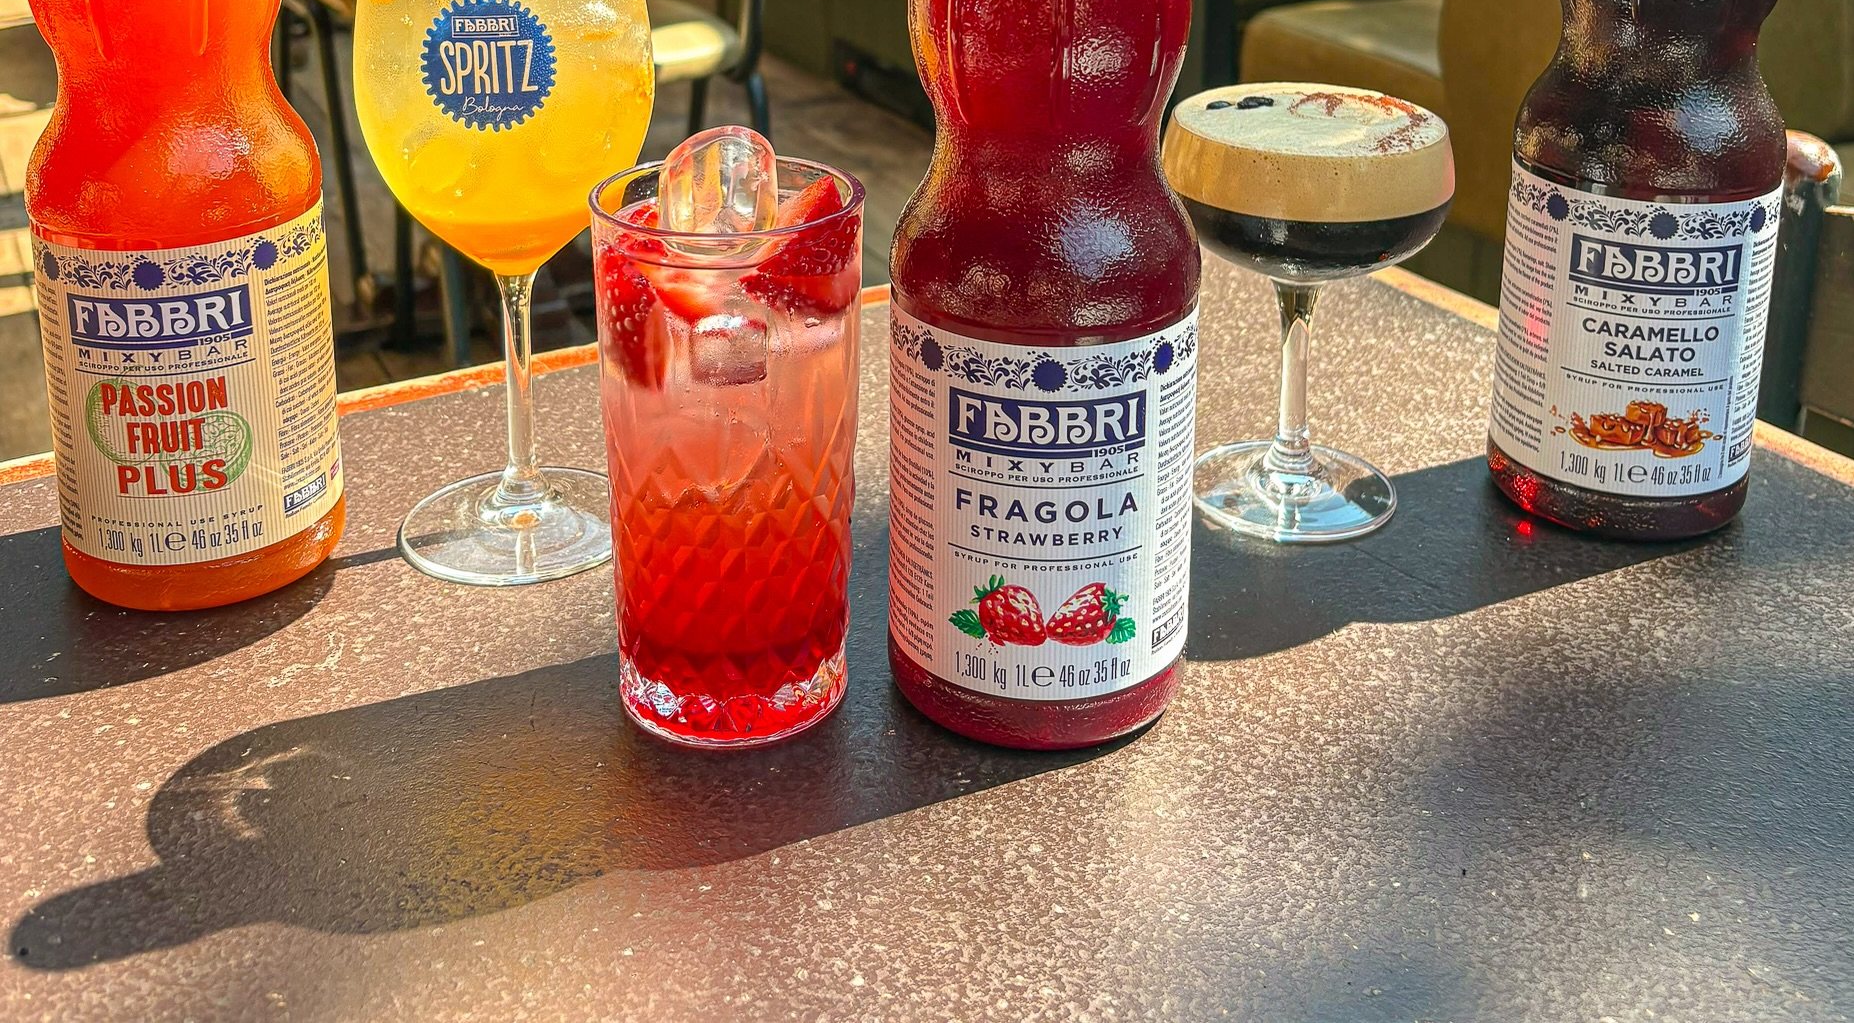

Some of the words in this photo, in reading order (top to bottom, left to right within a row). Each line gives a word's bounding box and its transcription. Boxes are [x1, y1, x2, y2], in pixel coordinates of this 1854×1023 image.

[455, 18, 515, 32] FABBRI
[439, 39, 538, 95] SPRITZ
[462, 96, 524, 121] Bologna
[1577, 239, 1737, 285] FABBRI
[1574, 284, 1733, 308] MIXYBAR
[1695, 287, 1722, 296] 1905
[72, 290, 245, 338] FABBRI
[1573, 296, 1618, 310] SCIROPPO
[1620, 305, 1638, 313] PER
[1664, 306, 1731, 316] PROFESSIONALE
[200, 333, 231, 346] 1905
[1582, 317, 1719, 343] CARAMELLO
[78, 338, 248, 363] MIXYBAR
[79, 361, 120, 371] SCIROPPO
[144, 364, 165, 372] USO
[168, 351, 248, 370] PROFESSIONALE
[1604, 341, 1696, 362] SALATO
[1590, 360, 1641, 375] SALTED
[1645, 367, 1704, 377] CARAMEL
[1566, 374, 1598, 385] SYRUP
[1602, 382, 1622, 390] FOR
[1627, 385, 1704, 394] PROFESSIONAL
[1708, 384, 1724, 392] USE
[100, 376, 228, 417] PASSION
[956, 394, 1140, 445] FABBRI
[126, 417, 206, 454] FRUIT
[956, 449, 1139, 473] MIXYBAR
[1093, 445, 1124, 457] 1905
[117, 459, 228, 495] PLUS
[955, 463, 1004, 479] SCIROPPO
[1008, 474, 1028, 482] PER
[1058, 466, 1139, 483] PROFESSIONALE
[1594, 459, 1606, 484] kg
[1651, 466, 1664, 485] 46
[1667, 471, 1678, 485] oz
[1680, 465, 1692, 484] 35
[1694, 464, 1701, 483] fl
[1702, 466, 1711, 481] oz
[286, 474, 326, 508] FABBRI
[91, 515, 183, 528] PROFESSIONAL
[190, 516, 215, 525] USE
[223, 504, 263, 520] SYRUP
[956, 488, 1139, 524] FRAGOLA
[99, 528, 125, 551] 1,300
[130, 533, 143, 557] kg
[191, 529, 207, 549] 46
[210, 532, 222, 547] oz
[224, 522, 239, 545] 35
[242, 520, 249, 540] fl
[252, 520, 263, 537] oz
[970, 525, 1123, 546] STRAWBERRY
[954, 550, 989, 565] SYRUP
[994, 562, 1017, 570] FOR
[1023, 559, 1114, 572] PROFESSIONAL
[1119, 552, 1138, 564] USE
[955, 651, 985, 681] 1,300
[993, 661, 1006, 690] kg
[1059, 665, 1075, 688] 46
[1078, 669, 1090, 686] oz
[1094, 659, 1108, 684] 35
[1111, 657, 1118, 680] fl
[1121, 658, 1131, 677] oz
